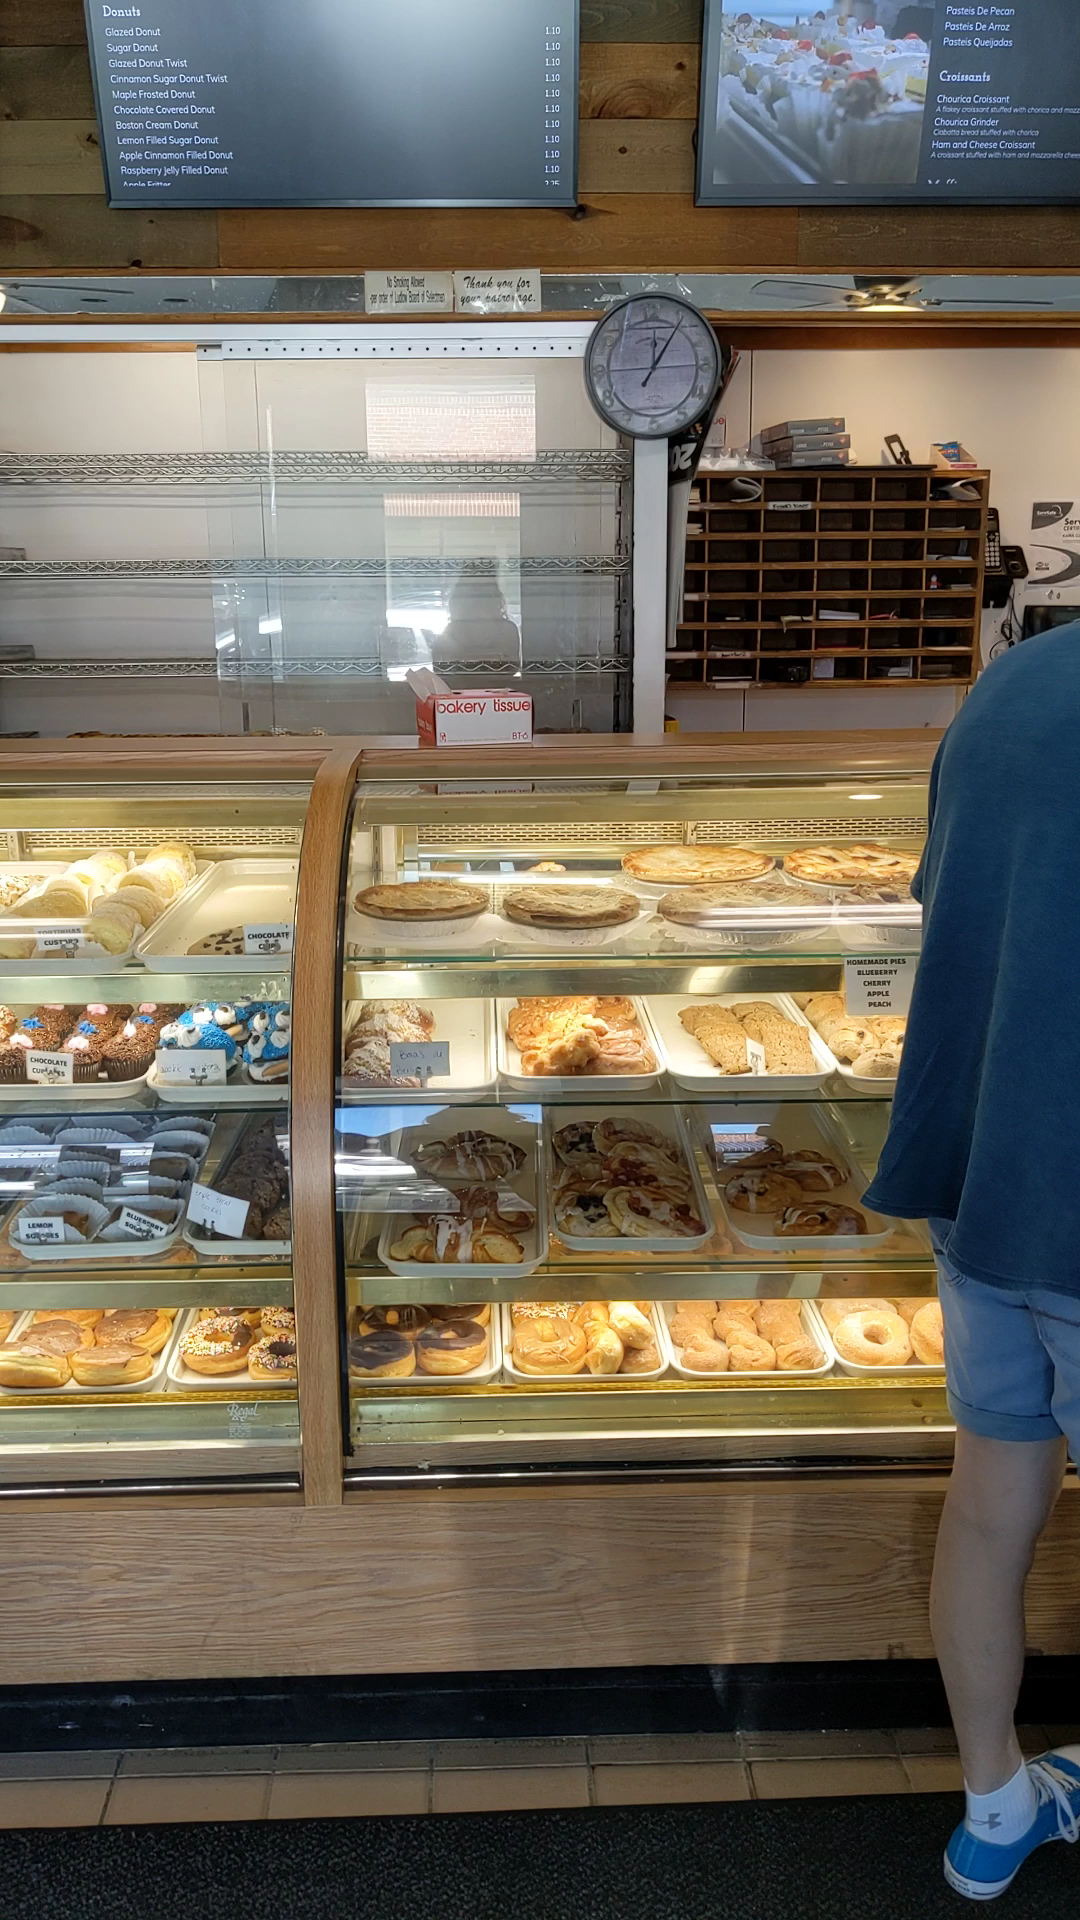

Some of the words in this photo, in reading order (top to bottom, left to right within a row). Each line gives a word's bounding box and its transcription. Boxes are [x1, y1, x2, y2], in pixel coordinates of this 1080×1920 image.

[103, 5, 141, 17] Donuts
[946, 6, 975, 16] Pasteis
[977, 7, 988, 15] De
[990, 7, 1014, 16] Pecan
[945, 22, 973, 31] Pasteis
[975, 23, 986, 31] De
[988, 23, 1010, 31] Arroz
[105, 28, 134, 37] Glazed
[136, 28, 161, 36] Donut
[943, 38, 972, 47] Pasteis
[974, 38, 1013, 48] Queijadas
[107, 44, 131, 54] Sugar
[133, 44, 158, 52] Donut
[109, 59, 137, 68] Glazed
[139, 60, 164, 68] Donut
[165, 59, 187, 67] Twist
[545, 58, 560, 66] 1.10
[110, 75, 152, 83] Cinnamon
[153, 75, 177, 85] Sugar
[180, 75, 204, 83] Donut
[206, 74, 228, 82] Twist
[545, 74, 560, 82] 1.10
[939, 71, 991, 82] Croissants
[112, 90, 137, 100] Maple
[139, 90, 169, 99] Frosted
[171, 90, 195, 99] Donut
[973, 95, 1009, 104] Croissant
[114, 106, 154, 114] Chocolate
[156, 106, 188, 114] Covered
[191, 106, 215, 114] Donut
[942, 106, 960, 114] flakey
[116, 121, 144, 129] Boston
[145, 121, 172, 129] Cream
[174, 121, 198, 129] Donut
[970, 118, 999, 126] Grinder
[117, 137, 144, 145] Lemon
[169, 137, 192, 146] Sugar
[195, 136, 219, 144] Donut
[932, 141, 951, 149] Ham
[952, 141, 968, 149] and
[969, 141, 998, 149] Cheese
[1000, 141, 1035, 149] Croissant
[119, 152, 142, 162] Apple
[144, 152, 184, 160] Cinnamon
[187, 152, 207, 160] Filled
[209, 151, 233, 159] Donut
[121, 166, 162, 176] Raspberry
[164, 166, 180, 176] Jelly
[182, 166, 202, 174] Filled
[204, 166, 228, 174] Donut
[387, 276, 392, 288] No
[394, 276, 409, 291] Smoking
[411, 276, 425, 287] Allowed
[464, 276, 493, 288] Thank
[497, 280, 513, 290] you
[516, 277, 530, 292] for
[379, 292, 388, 303] order
[390, 291, 393, 303] of
[409, 291, 420, 303] Board
[421, 291, 425, 303] of
[437, 701, 486, 715] bakery
[493, 699, 530, 712] tissue
[30, 1057, 67, 1066] CHOCOLATE
[227, 1402, 260, 1421] Regal
